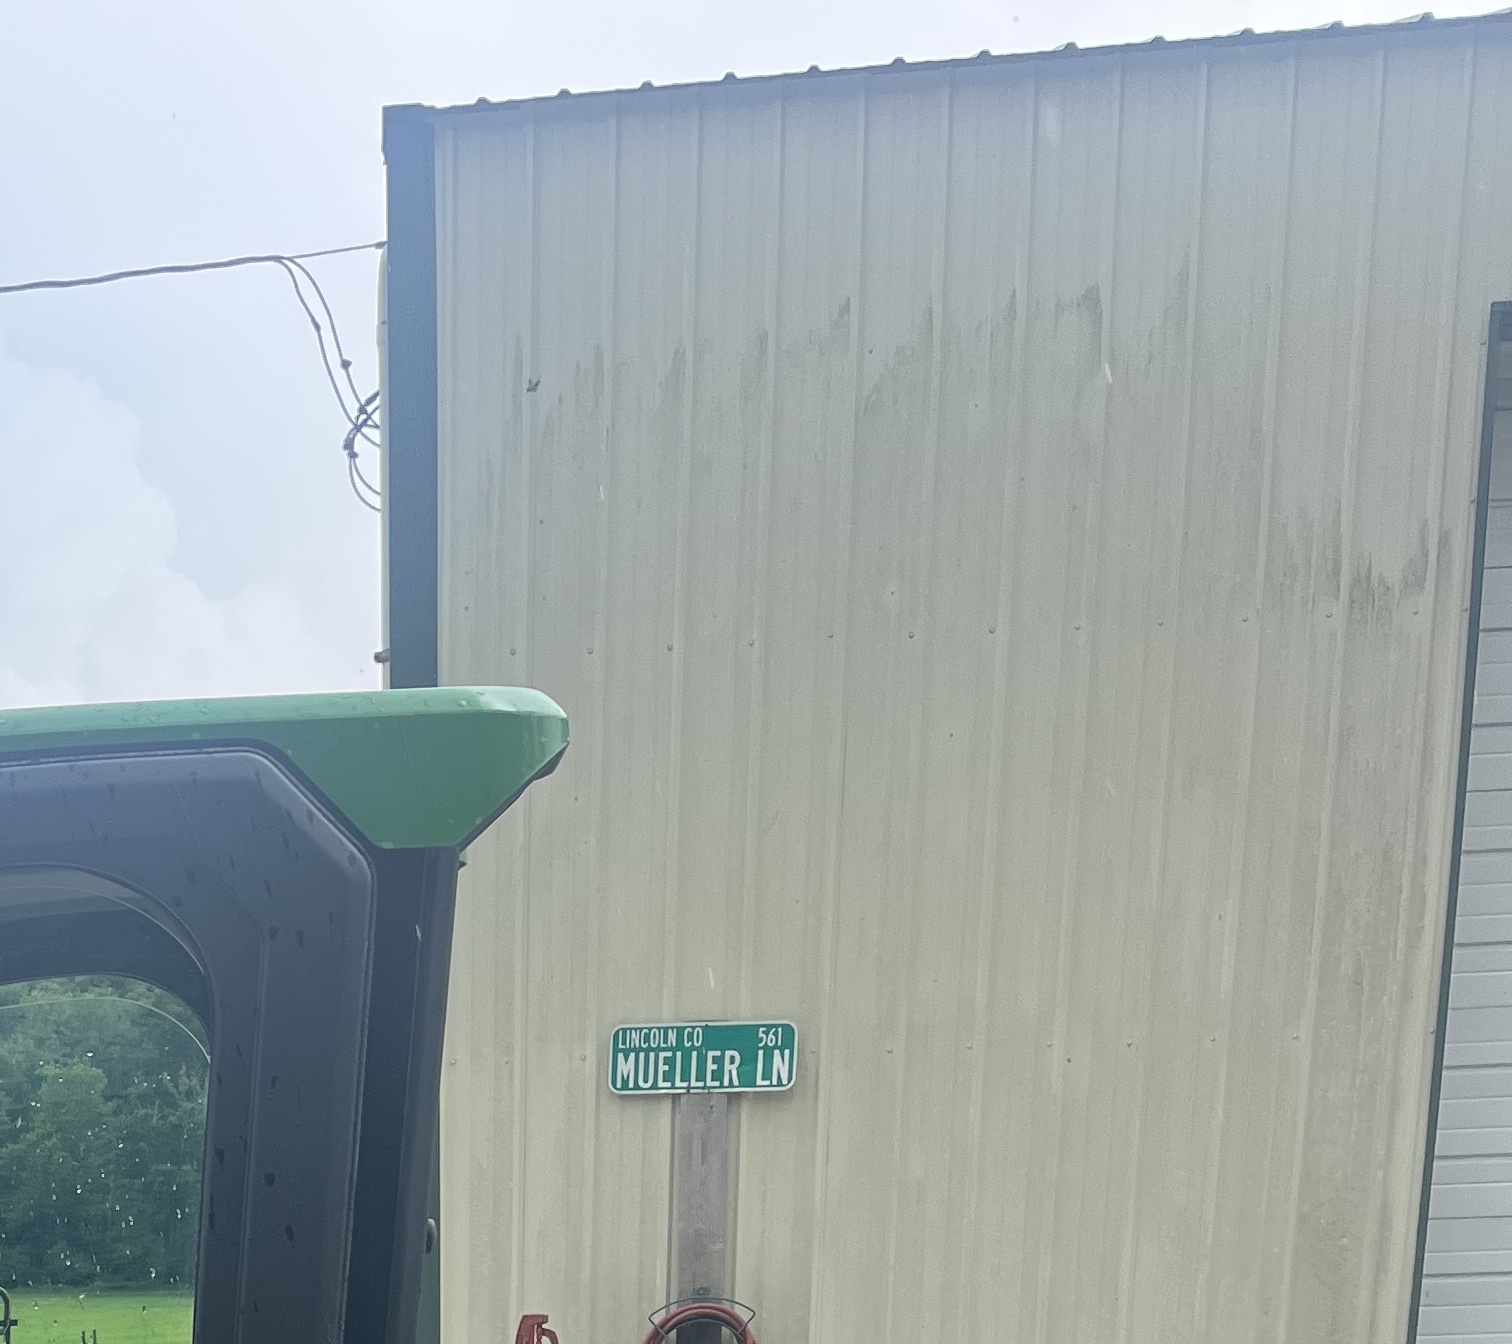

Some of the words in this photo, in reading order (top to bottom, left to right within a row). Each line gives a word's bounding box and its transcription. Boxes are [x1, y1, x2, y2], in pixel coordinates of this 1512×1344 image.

[618, 1027, 677, 1049] LINCOLN
[683, 1026, 703, 1047] CO
[758, 1026, 783, 1047] 561
[616, 1049, 741, 1089] MUELLER
[755, 1048, 790, 1087] LN
